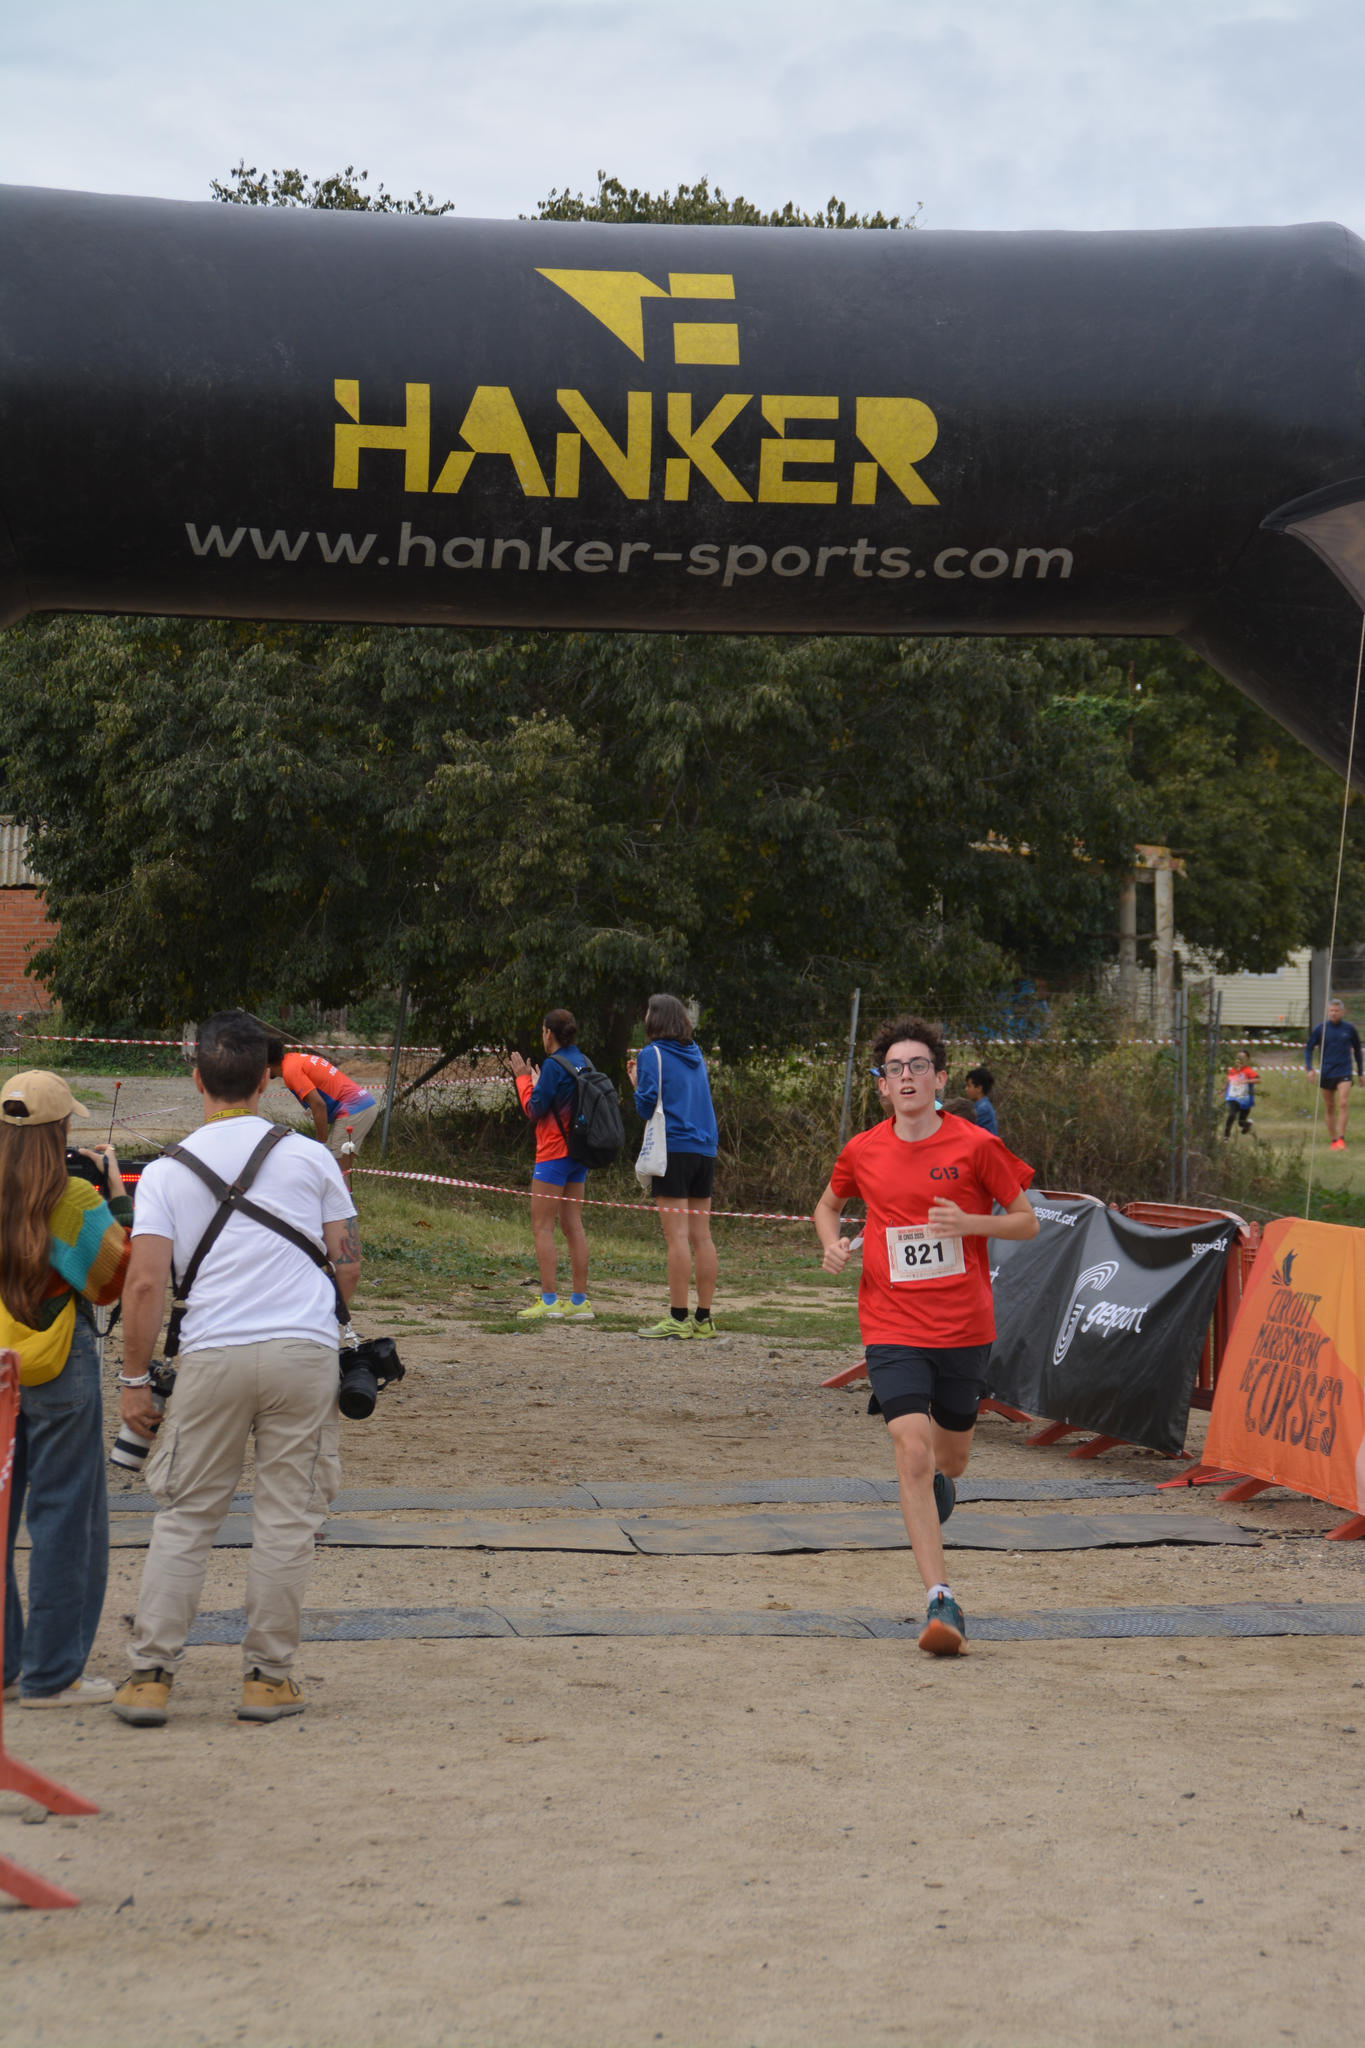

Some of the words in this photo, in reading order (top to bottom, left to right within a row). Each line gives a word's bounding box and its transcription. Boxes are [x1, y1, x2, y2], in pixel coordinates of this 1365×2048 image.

[333, 378, 941, 506] HANKER
[184, 521, 1075, 588] www.hanker-sports.com
[1033, 1206, 1078, 1227] esport.cat
[904, 1241, 944, 1266] 821
[1081, 1301, 1151, 1337] gesport
[1266, 1288, 1322, 1329] CIRCUIT
[1245, 1361, 1344, 1456] CURSES
